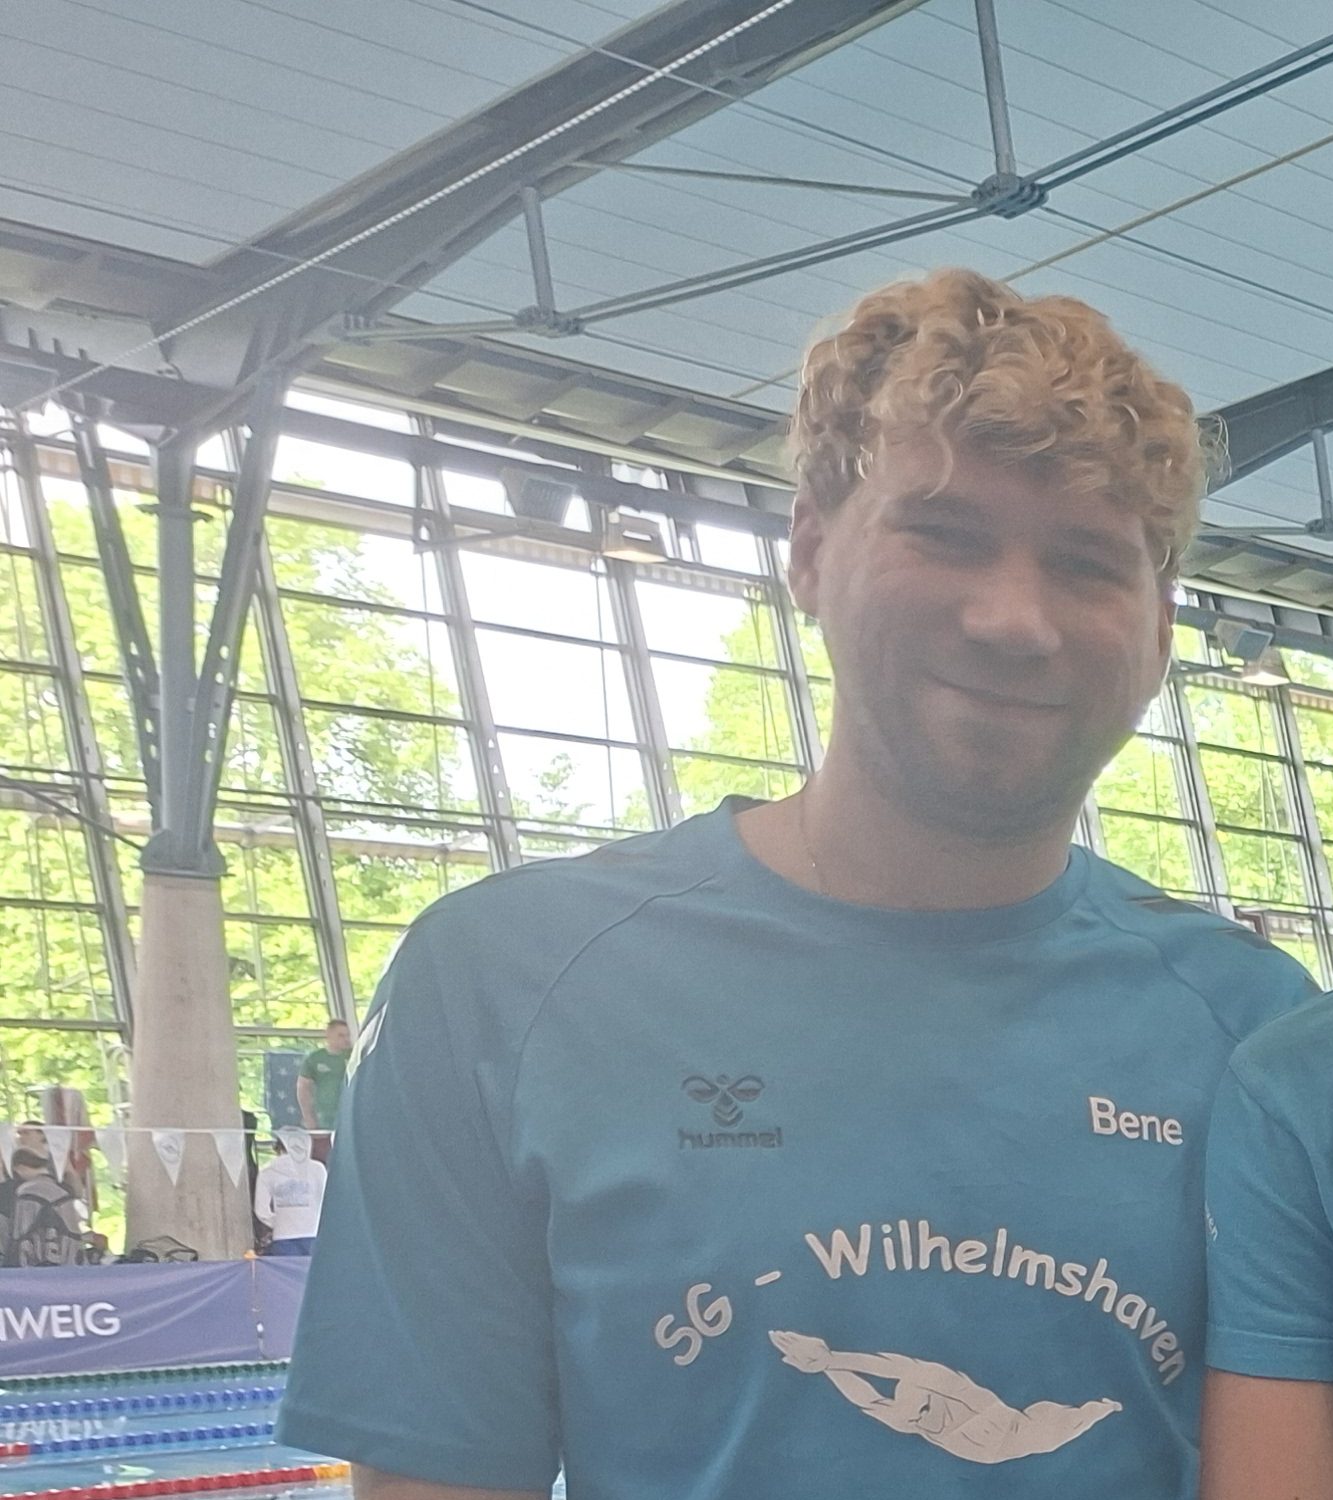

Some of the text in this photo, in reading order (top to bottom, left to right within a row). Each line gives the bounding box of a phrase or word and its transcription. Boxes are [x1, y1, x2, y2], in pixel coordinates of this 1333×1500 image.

[678, 1127, 783, 1149] hummel
[1089, 1096, 1184, 1146] Bene
[655, 1283, 733, 1366] SG
[805, 1220, 1187, 1385] Wilhelmshaven
